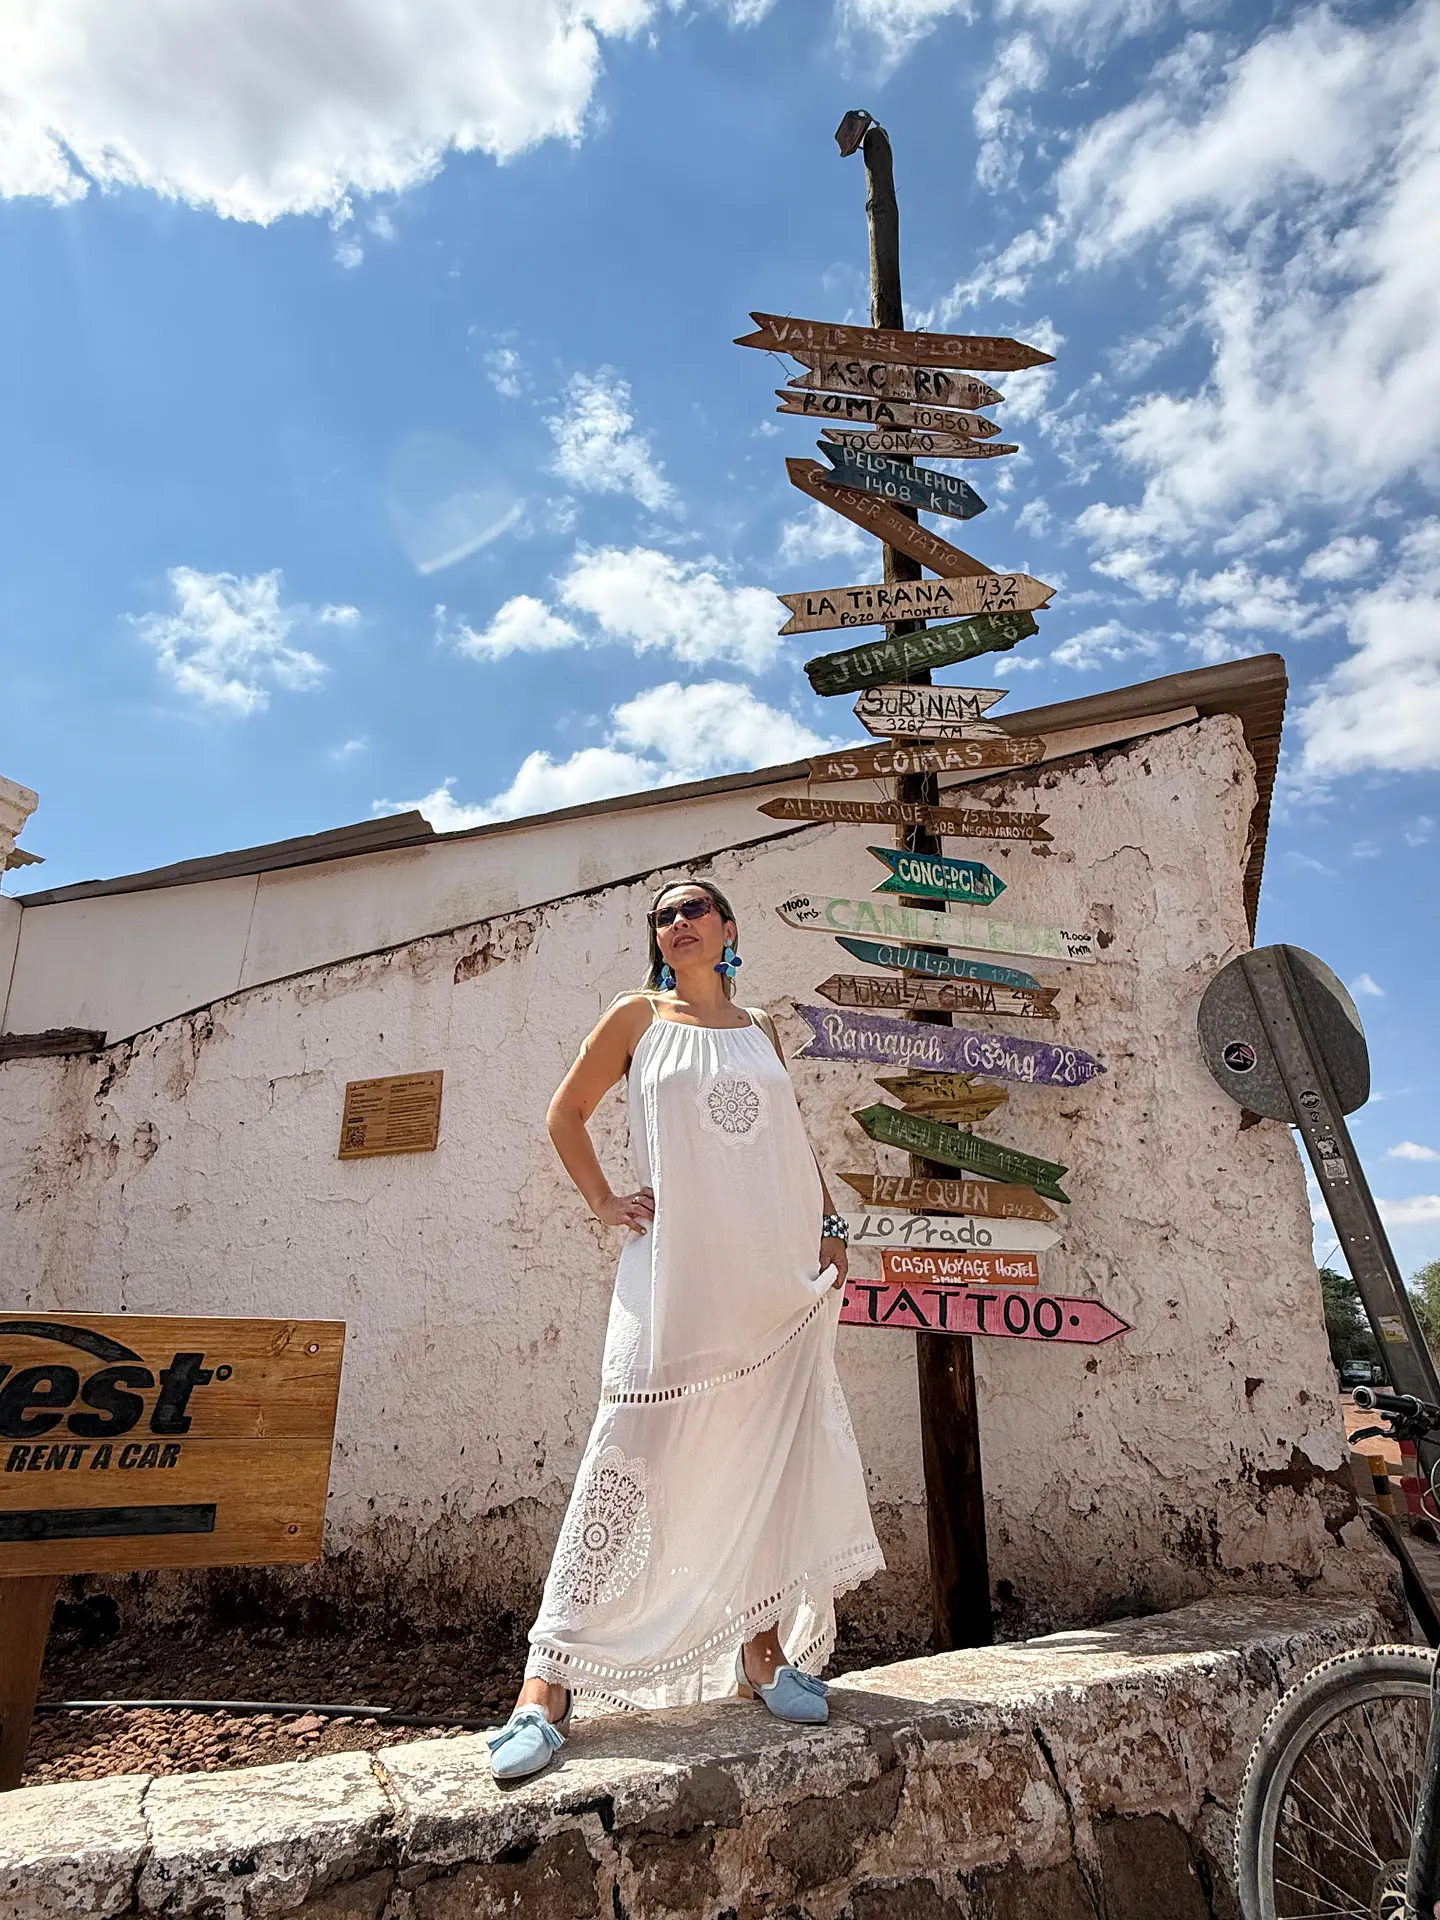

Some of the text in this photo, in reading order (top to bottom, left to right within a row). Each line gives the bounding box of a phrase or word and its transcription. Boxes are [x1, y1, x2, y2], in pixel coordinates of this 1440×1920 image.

[803, 393, 895, 422] ROMA
[913, 410, 970, 433] 10950
[839, 433, 934, 451] TOCONAO
[807, 468, 882, 519] GSER
[864, 475, 964, 517] 1408 KM
[807, 597, 836, 616] LA
[977, 577, 1019, 598] 432
[881, 611, 898, 620] AL
[902, 604, 950, 616] MONTE
[980, 598, 1016, 612] KM
[831, 625, 981, 684] JUMANJI
[939, 725, 962, 738] KM
[783, 800, 923, 822] ALBUQUERQUE
[822, 1014, 944, 1065] Ramayah
[899, 1216, 993, 1247] Prado
[890, 1255, 936, 1273] CASA
[994, 1257, 1037, 1277] HOSTEL
[855, 1285, 1063, 1338] TATTOO
[0, 1352, 215, 1438] est
[4, 1443, 181, 1472] RENT A CAR
